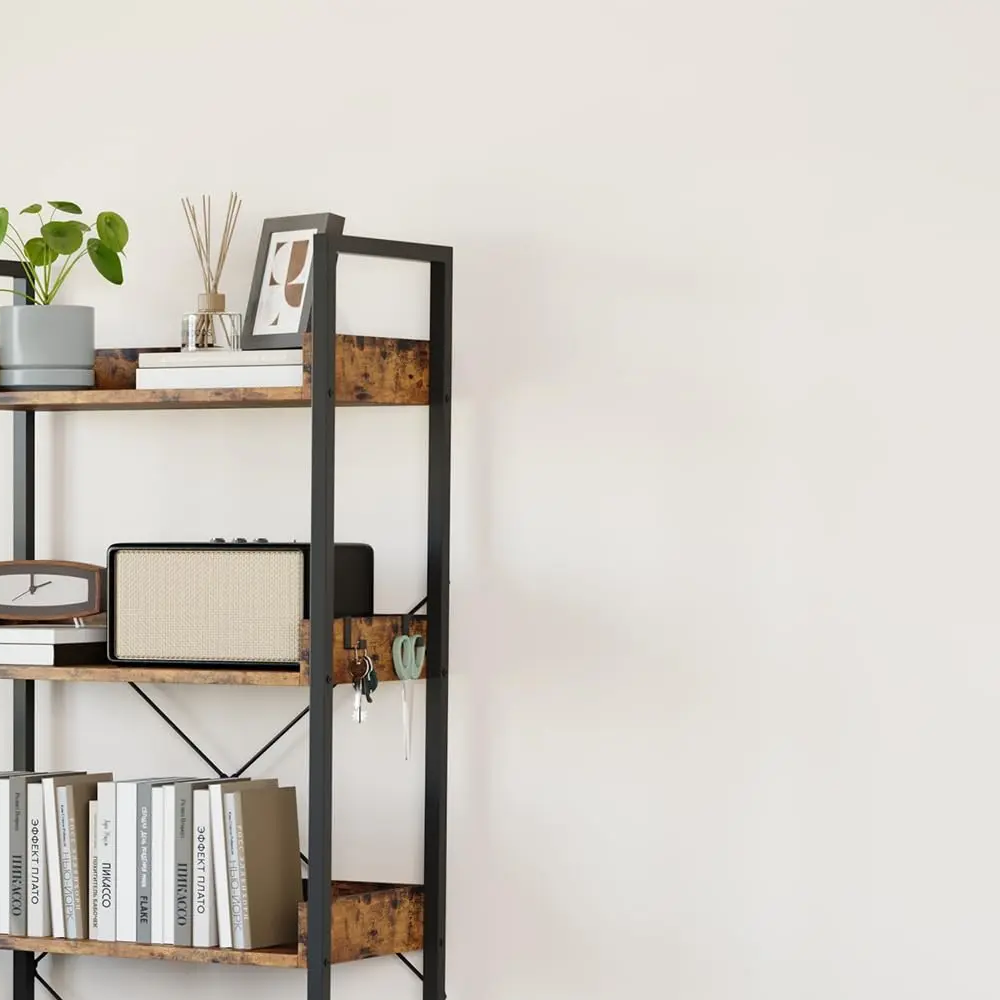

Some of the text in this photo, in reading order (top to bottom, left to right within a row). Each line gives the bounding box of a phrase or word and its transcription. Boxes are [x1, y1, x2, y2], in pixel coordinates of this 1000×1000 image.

[12, 855, 22, 917] ПИКАССО
[31, 819, 39, 904] ЭФФЕКТ ПЛАТО
[102, 862, 111, 908] ПИКАССО
[197, 826, 205, 914] ЭФФЕКТ ПЛАТО
[140, 895, 149, 924] FLAKE
[177, 863, 188, 926] ПИКАССО
